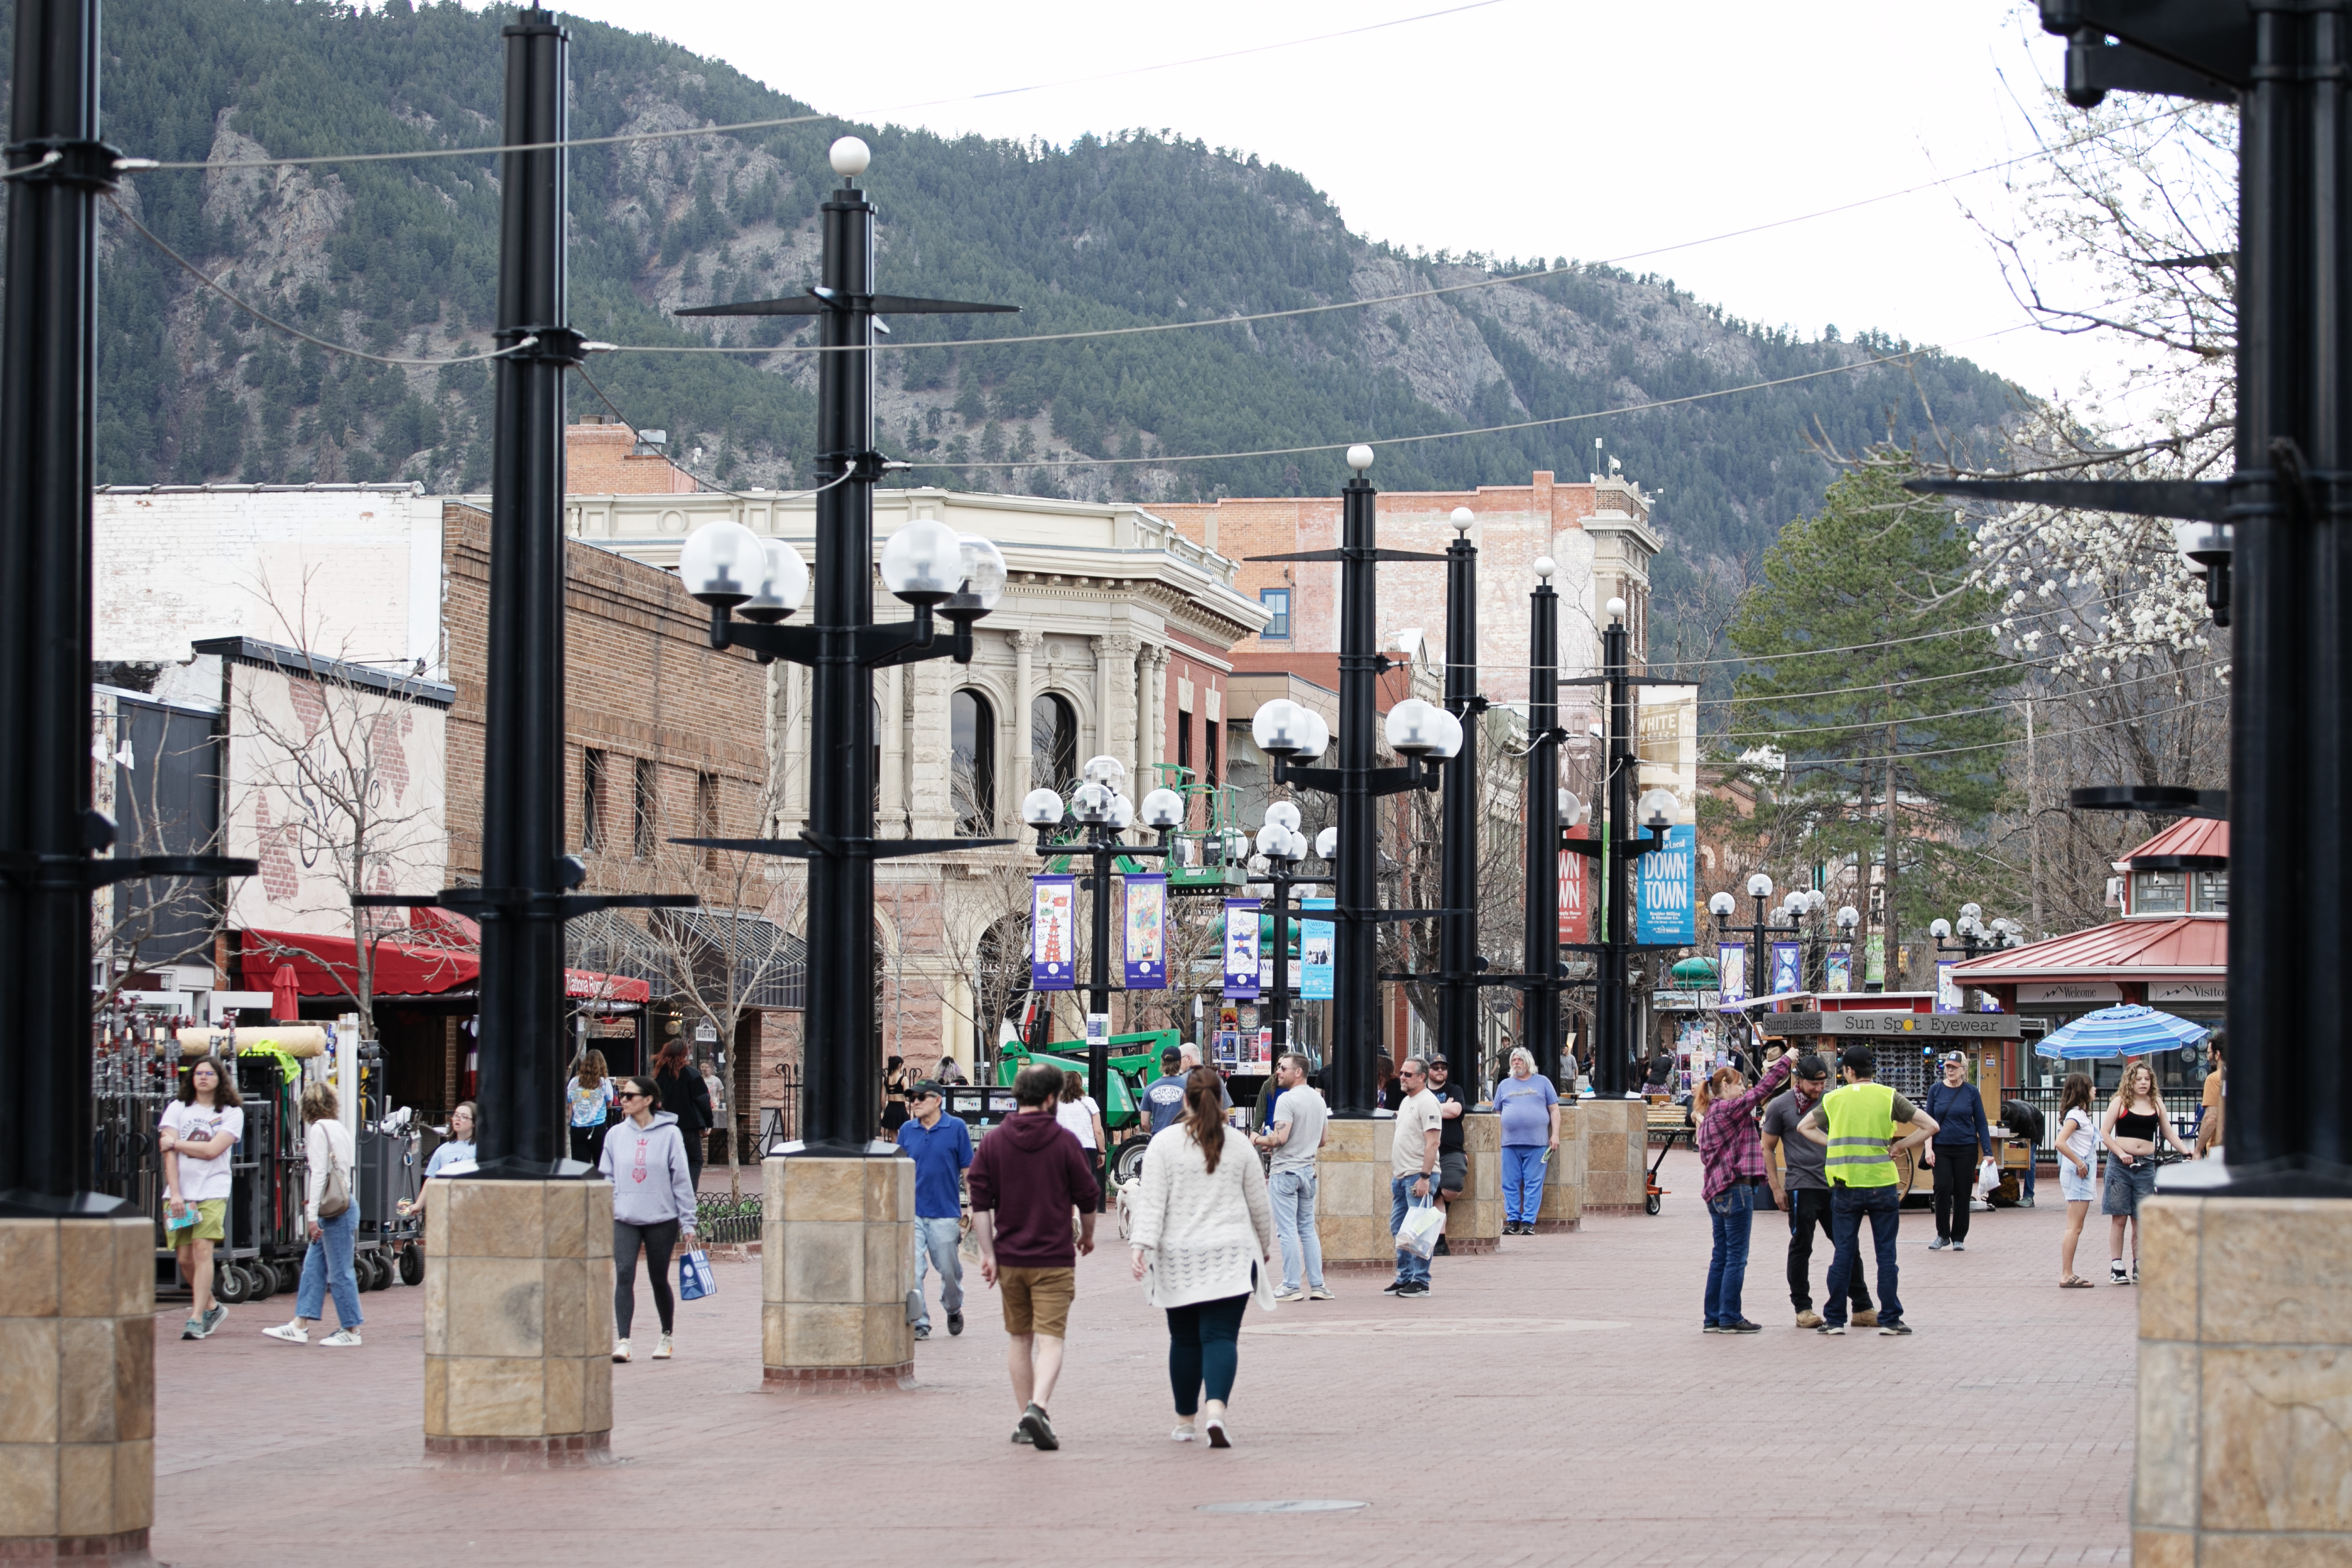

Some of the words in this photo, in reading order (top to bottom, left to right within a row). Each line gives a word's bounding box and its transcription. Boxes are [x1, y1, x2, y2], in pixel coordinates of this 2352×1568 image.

[1669, 838, 1686, 849] Local
[1558, 852, 1580, 879] WN
[1645, 852, 1687, 880] DOWN
[1558, 880, 1580, 908] WN
[1644, 881, 1687, 909] TOWN
[2064, 987, 2096, 998] Welcome
[1764, 1017, 1821, 1032] Sunglasses
[1845, 1017, 1875, 1030] Sun
[1883, 1017, 1921, 1032] Spot
[1930, 1018, 1999, 1034] Eyewear
[635, 1147, 647, 1166] Q
